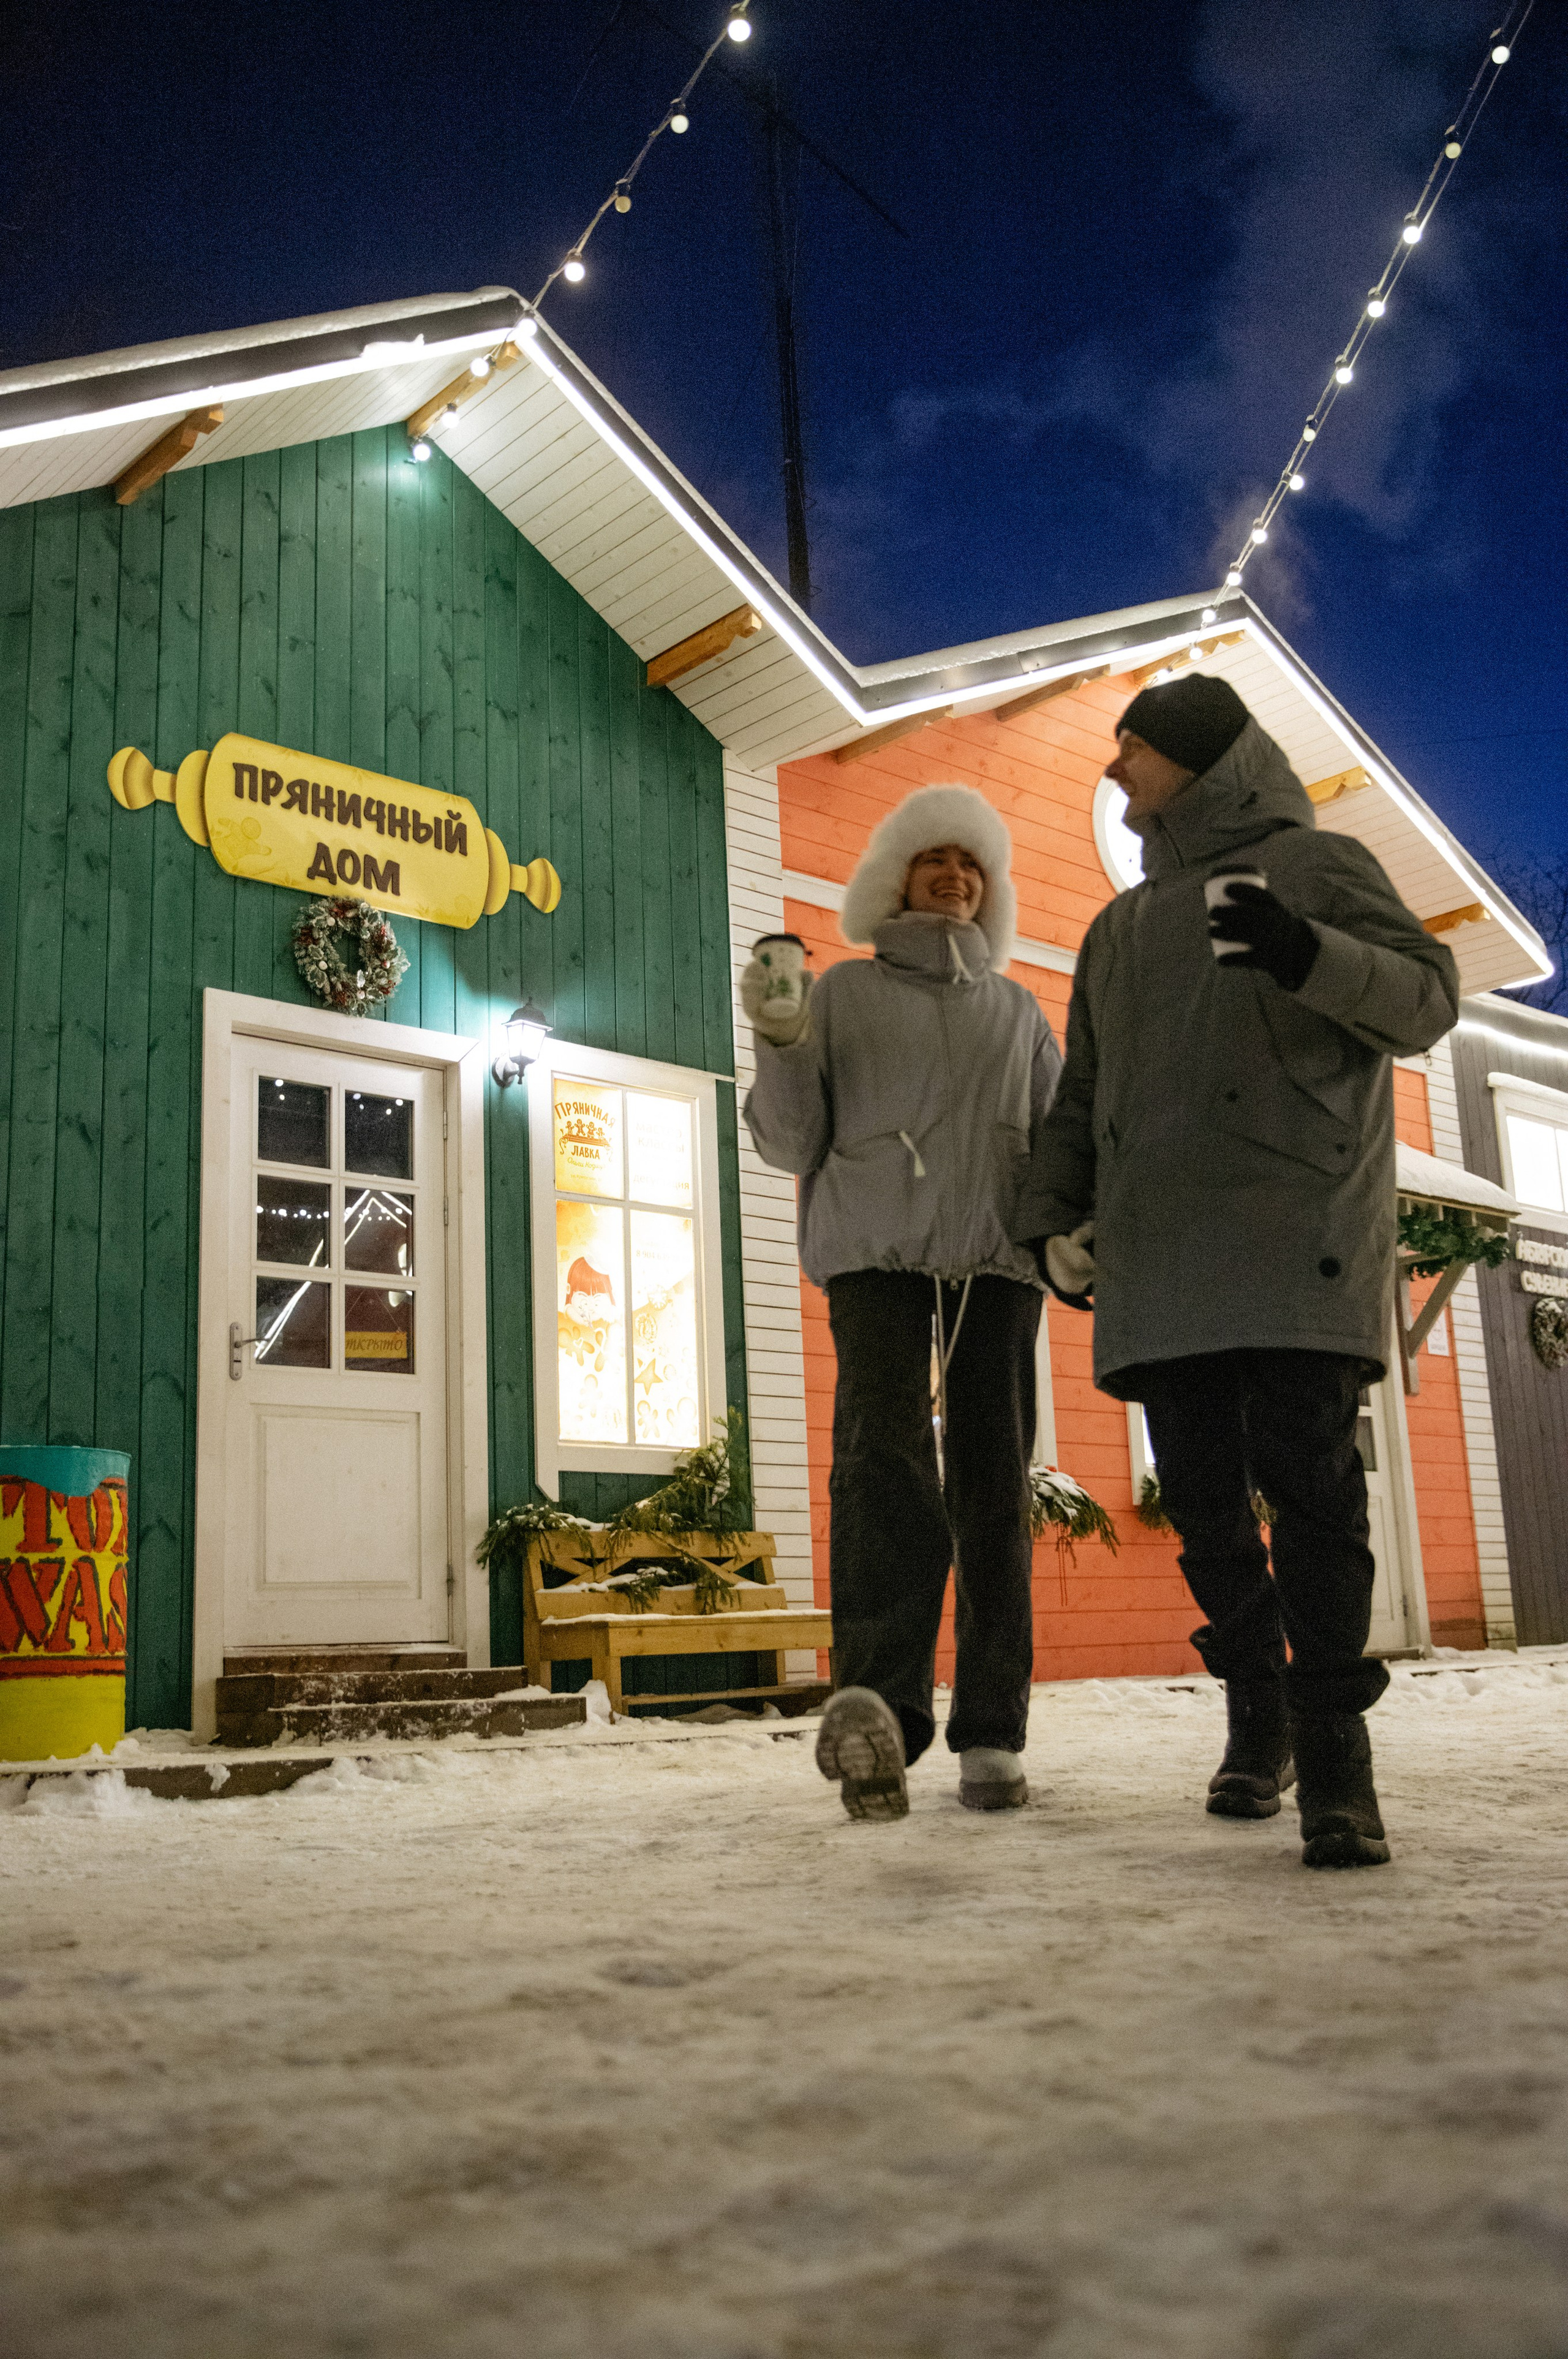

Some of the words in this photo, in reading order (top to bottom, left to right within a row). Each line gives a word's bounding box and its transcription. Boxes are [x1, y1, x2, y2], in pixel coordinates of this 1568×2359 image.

[232, 762, 468, 856] ПРЯНИЧНЫЙ
[306, 842, 401, 896] ДОМ
[571, 1145, 600, 1160] ЛАВКА
